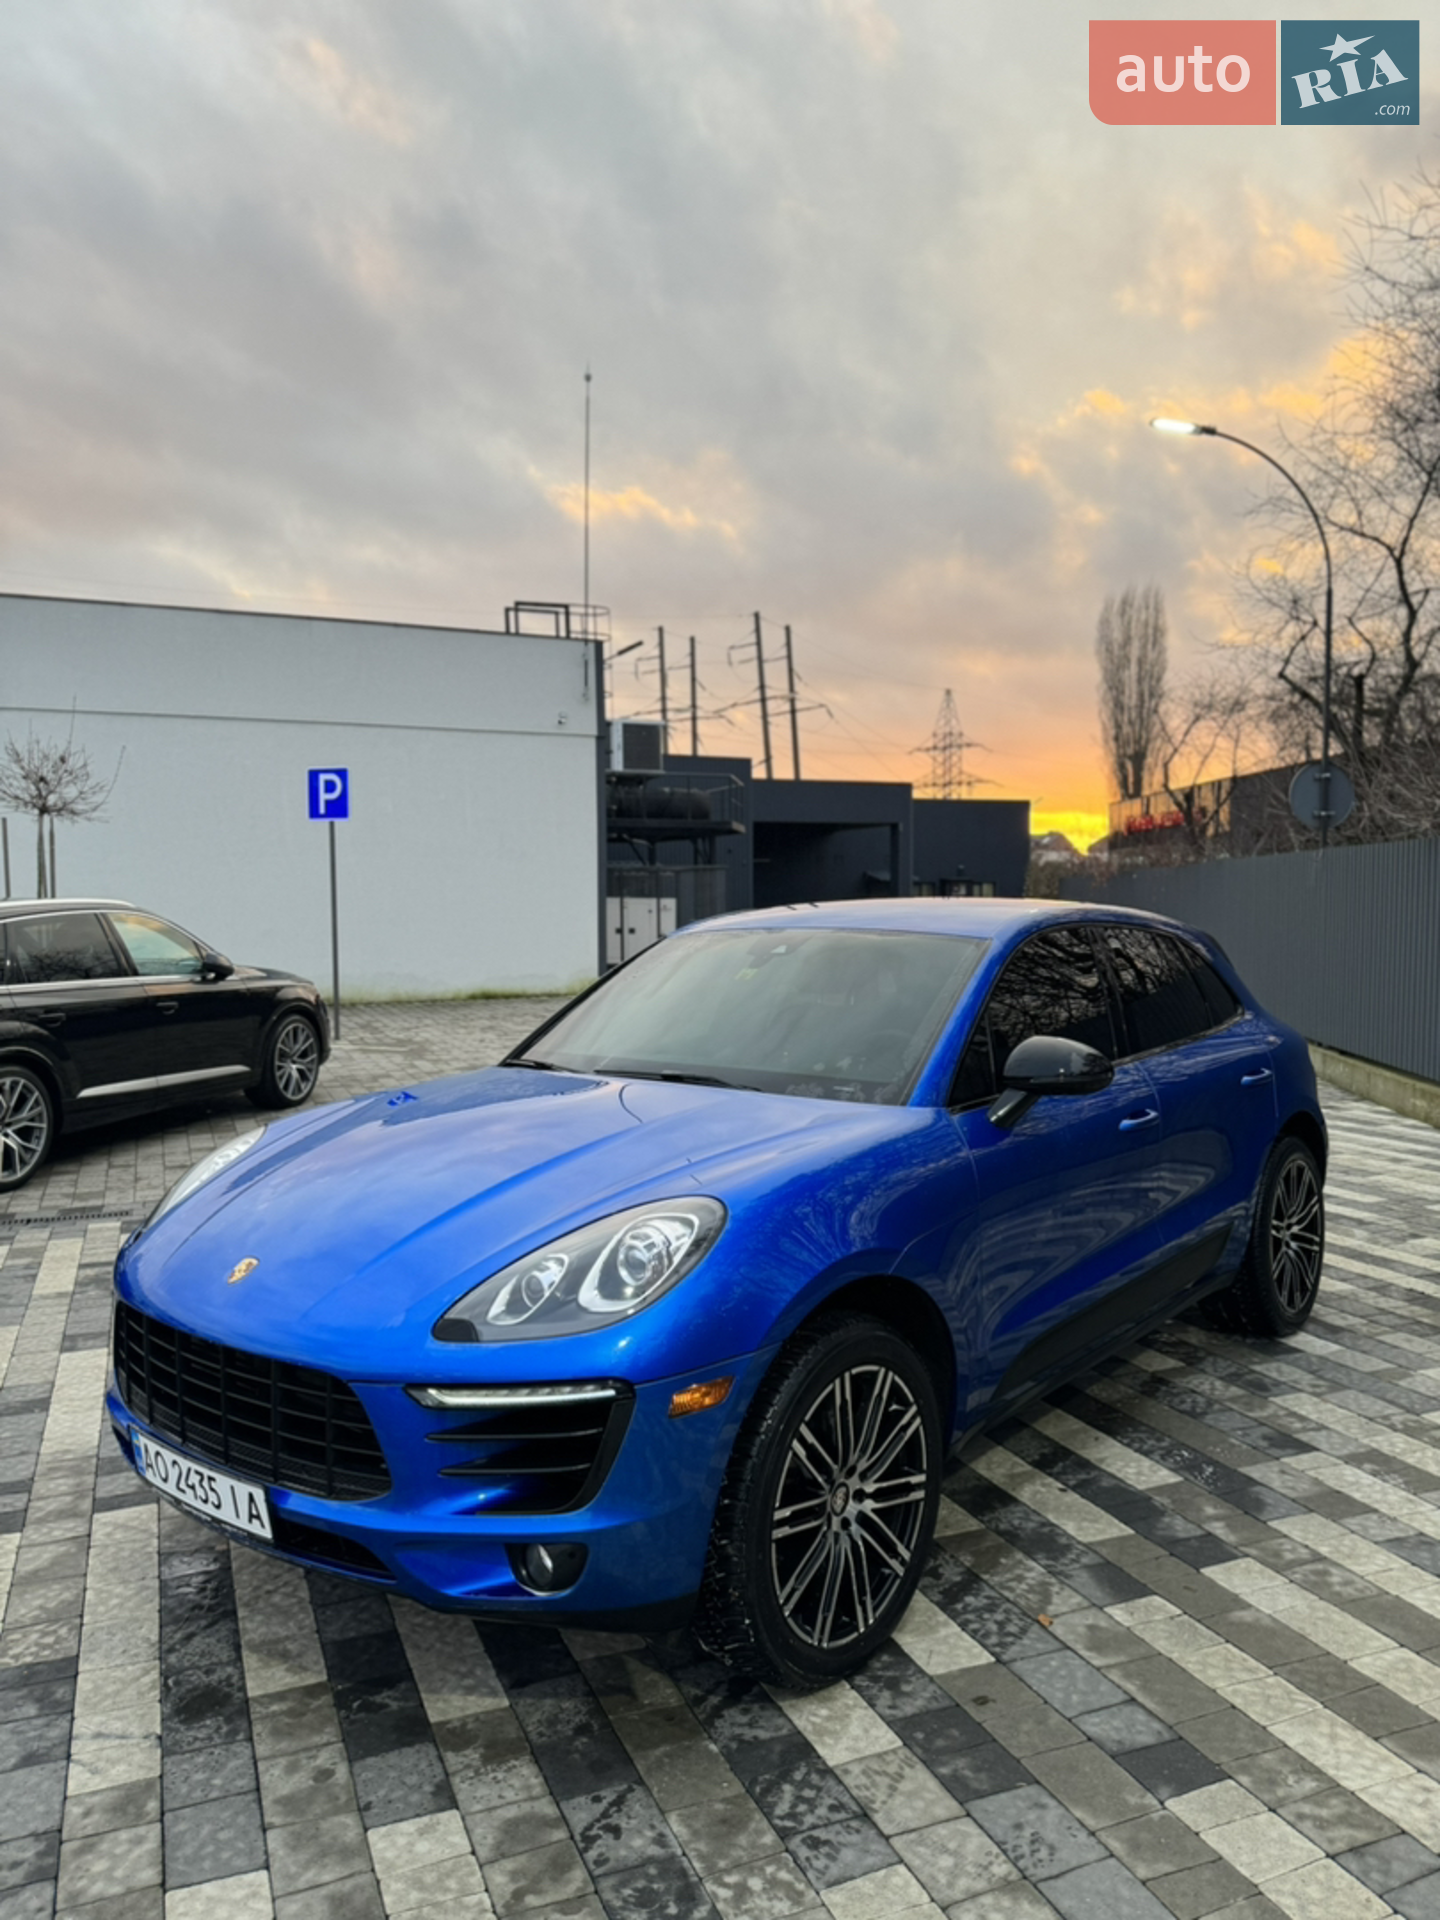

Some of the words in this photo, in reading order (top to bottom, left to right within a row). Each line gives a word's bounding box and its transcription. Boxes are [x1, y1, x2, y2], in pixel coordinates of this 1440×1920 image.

[318, 773, 343, 815] P
[144, 1443, 170, 1484] AO
[171, 1459, 222, 1510] 2435
[230, 1485, 266, 1530] IA
